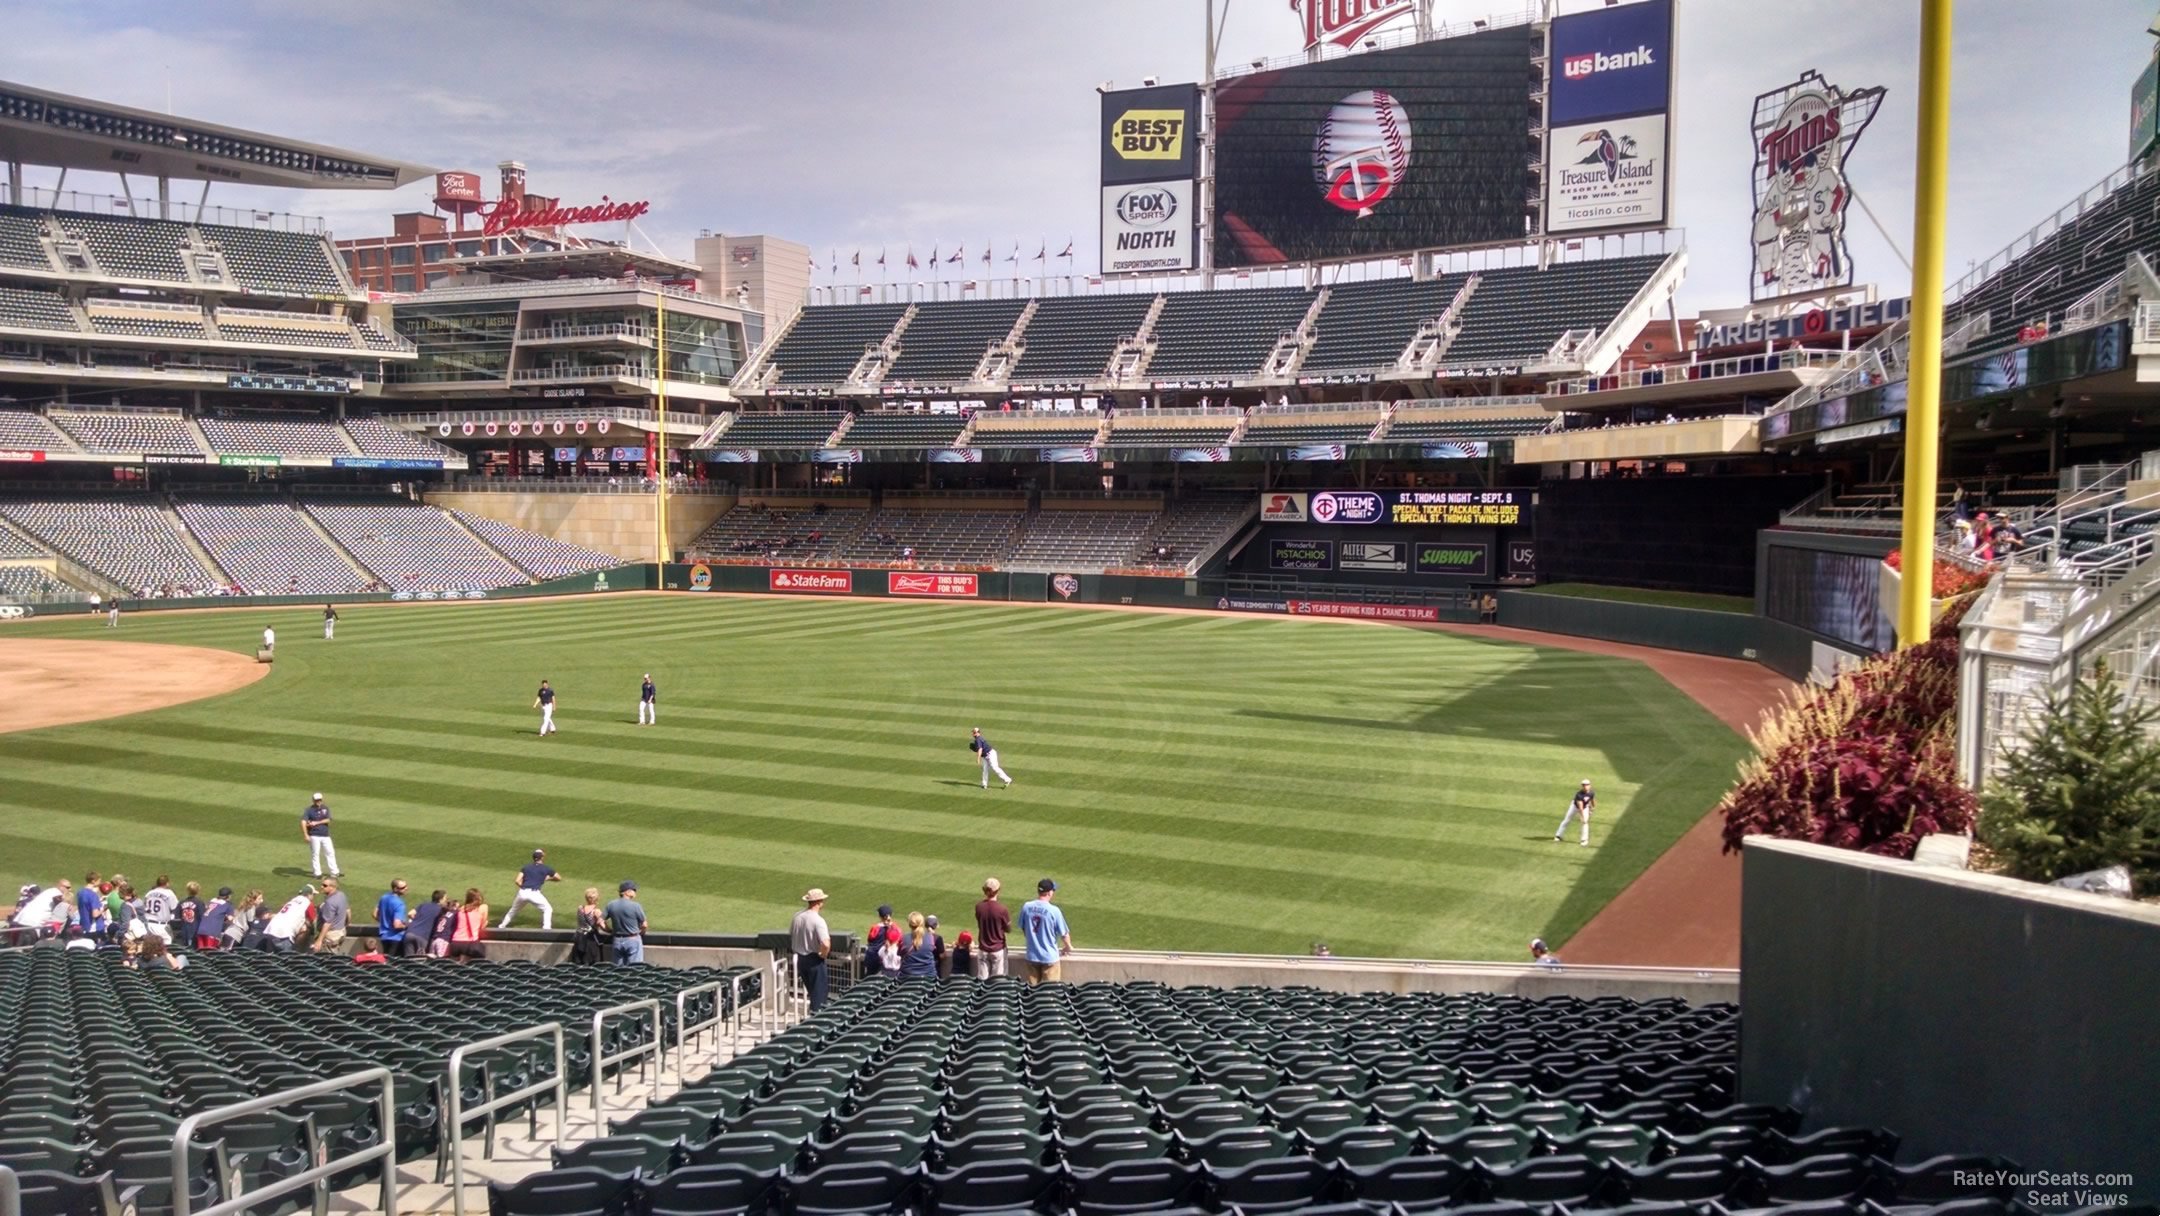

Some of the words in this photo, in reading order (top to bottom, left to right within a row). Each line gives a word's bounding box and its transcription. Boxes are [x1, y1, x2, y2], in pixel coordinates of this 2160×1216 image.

[1121, 119, 1182, 135] BEST
[1122, 136, 1176, 152] BUY
[1760, 106, 1840, 180] Twins
[1559, 169, 1606, 187] Treasure
[1618, 160, 1653, 180] Island
[442, 174, 464, 189] Ford
[1560, 185, 1597, 194] RESORT
[1613, 180, 1653, 189] CASINO
[446, 186, 475, 197] Center
[1129, 193, 1164, 213] FOX
[477, 195, 650, 235] Budweiser
[1128, 211, 1166, 221] SPORTS
[1568, 203, 1642, 219] ticasino.com
[1117, 230, 1176, 251] NORTH
[1113, 258, 1181, 270] FOXSPORTSNORTH.COM
[486, 317, 517, 327] BASEBALL
[1694, 317, 1795, 350] TARGET
[544, 389, 559, 398] GOOSE
[559, 388, 575, 397] ISLAND
[576, 388, 585, 397] PUB
[168, 456, 180, 464] ICE
[401, 460, 415, 468] Park
[1337, 497, 1375, 511] THEME
[1400, 493, 1412, 503] ST.
[1414, 493, 1446, 504] THOMAS
[1448, 493, 1472, 504] NIGHT
[1481, 493, 1504, 504] SEPT.
[1506, 493, 1512, 504] 9
[1346, 509, 1367, 519] NIGHT
[1392, 505, 1420, 514] SPECIAL
[1422, 505, 1447, 514] TICKET
[1449, 505, 1482, 515] PACKAGE
[1483, 505, 1519, 515] INCLUDES
[1393, 514, 1399, 523] A
[1400, 514, 1428, 523] SPECIAL
[1430, 514, 1441, 523] ST.
[1443, 514, 1472, 523] THOMAS
[1474, 514, 1499, 524] TWINS
[1500, 514, 1518, 524] CAP!
[1285, 541, 1317, 549] Wonderful
[1276, 549, 1326, 560] PISTACHIOS
[1420, 550, 1483, 565] SUBWAY
[1282, 560, 1295, 568] Get
[937, 576, 952, 584] THIS
[953, 577, 973, 585] BUD'S
[1065, 580, 1078, 591] 29
[938, 585, 951, 593] FOR
[951, 585, 966, 593] YOU.
[1230, 600, 1245, 608] TWINS
[1246, 601, 1274, 609] COMMUNITY
[1298, 602, 1311, 613] 25
[1311, 604, 1330, 613] YEARS
[1331, 605, 1339, 613] OF
[1340, 605, 1360, 615] GIVING
[1361, 606, 1375, 616] KIDS
[1376, 607, 1381, 616] A
[1382, 607, 1407, 617] CHANCE
[1408, 608, 1416, 617] TO
[1417, 608, 1434, 618] PLAY.
[147, 900, 161, 913] 16
